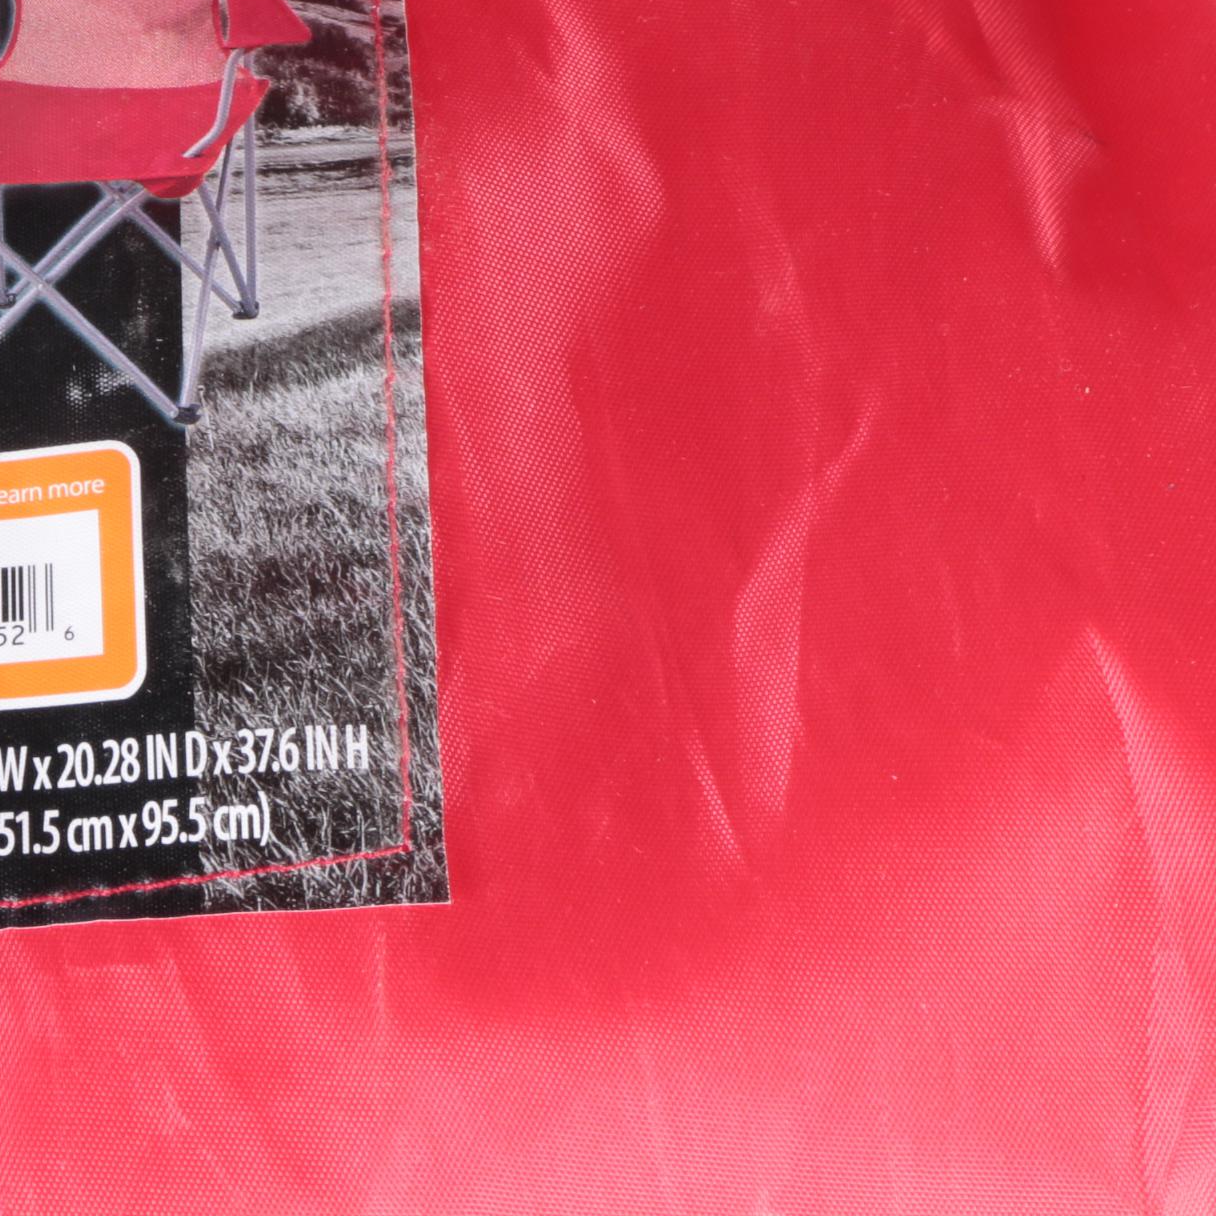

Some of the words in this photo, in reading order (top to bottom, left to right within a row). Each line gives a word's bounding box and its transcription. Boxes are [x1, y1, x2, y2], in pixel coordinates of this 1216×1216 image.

[48, 477, 106, 499] more
[64, 625, 76, 643] 6
[32, 759, 54, 791] x
[56, 736, 142, 790] 20.28
[146, 731, 179, 781] IN
[184, 730, 208, 779] D
[211, 744, 234, 776] x
[237, 725, 301, 775] 37.6
[306, 723, 338, 772] IN
[346, 723, 370, 771] H
[66, 816, 115, 853] cm
[117, 813, 140, 850] x
[141, 796, 209, 846] 95.5
[213, 789, 272, 846] cm)
